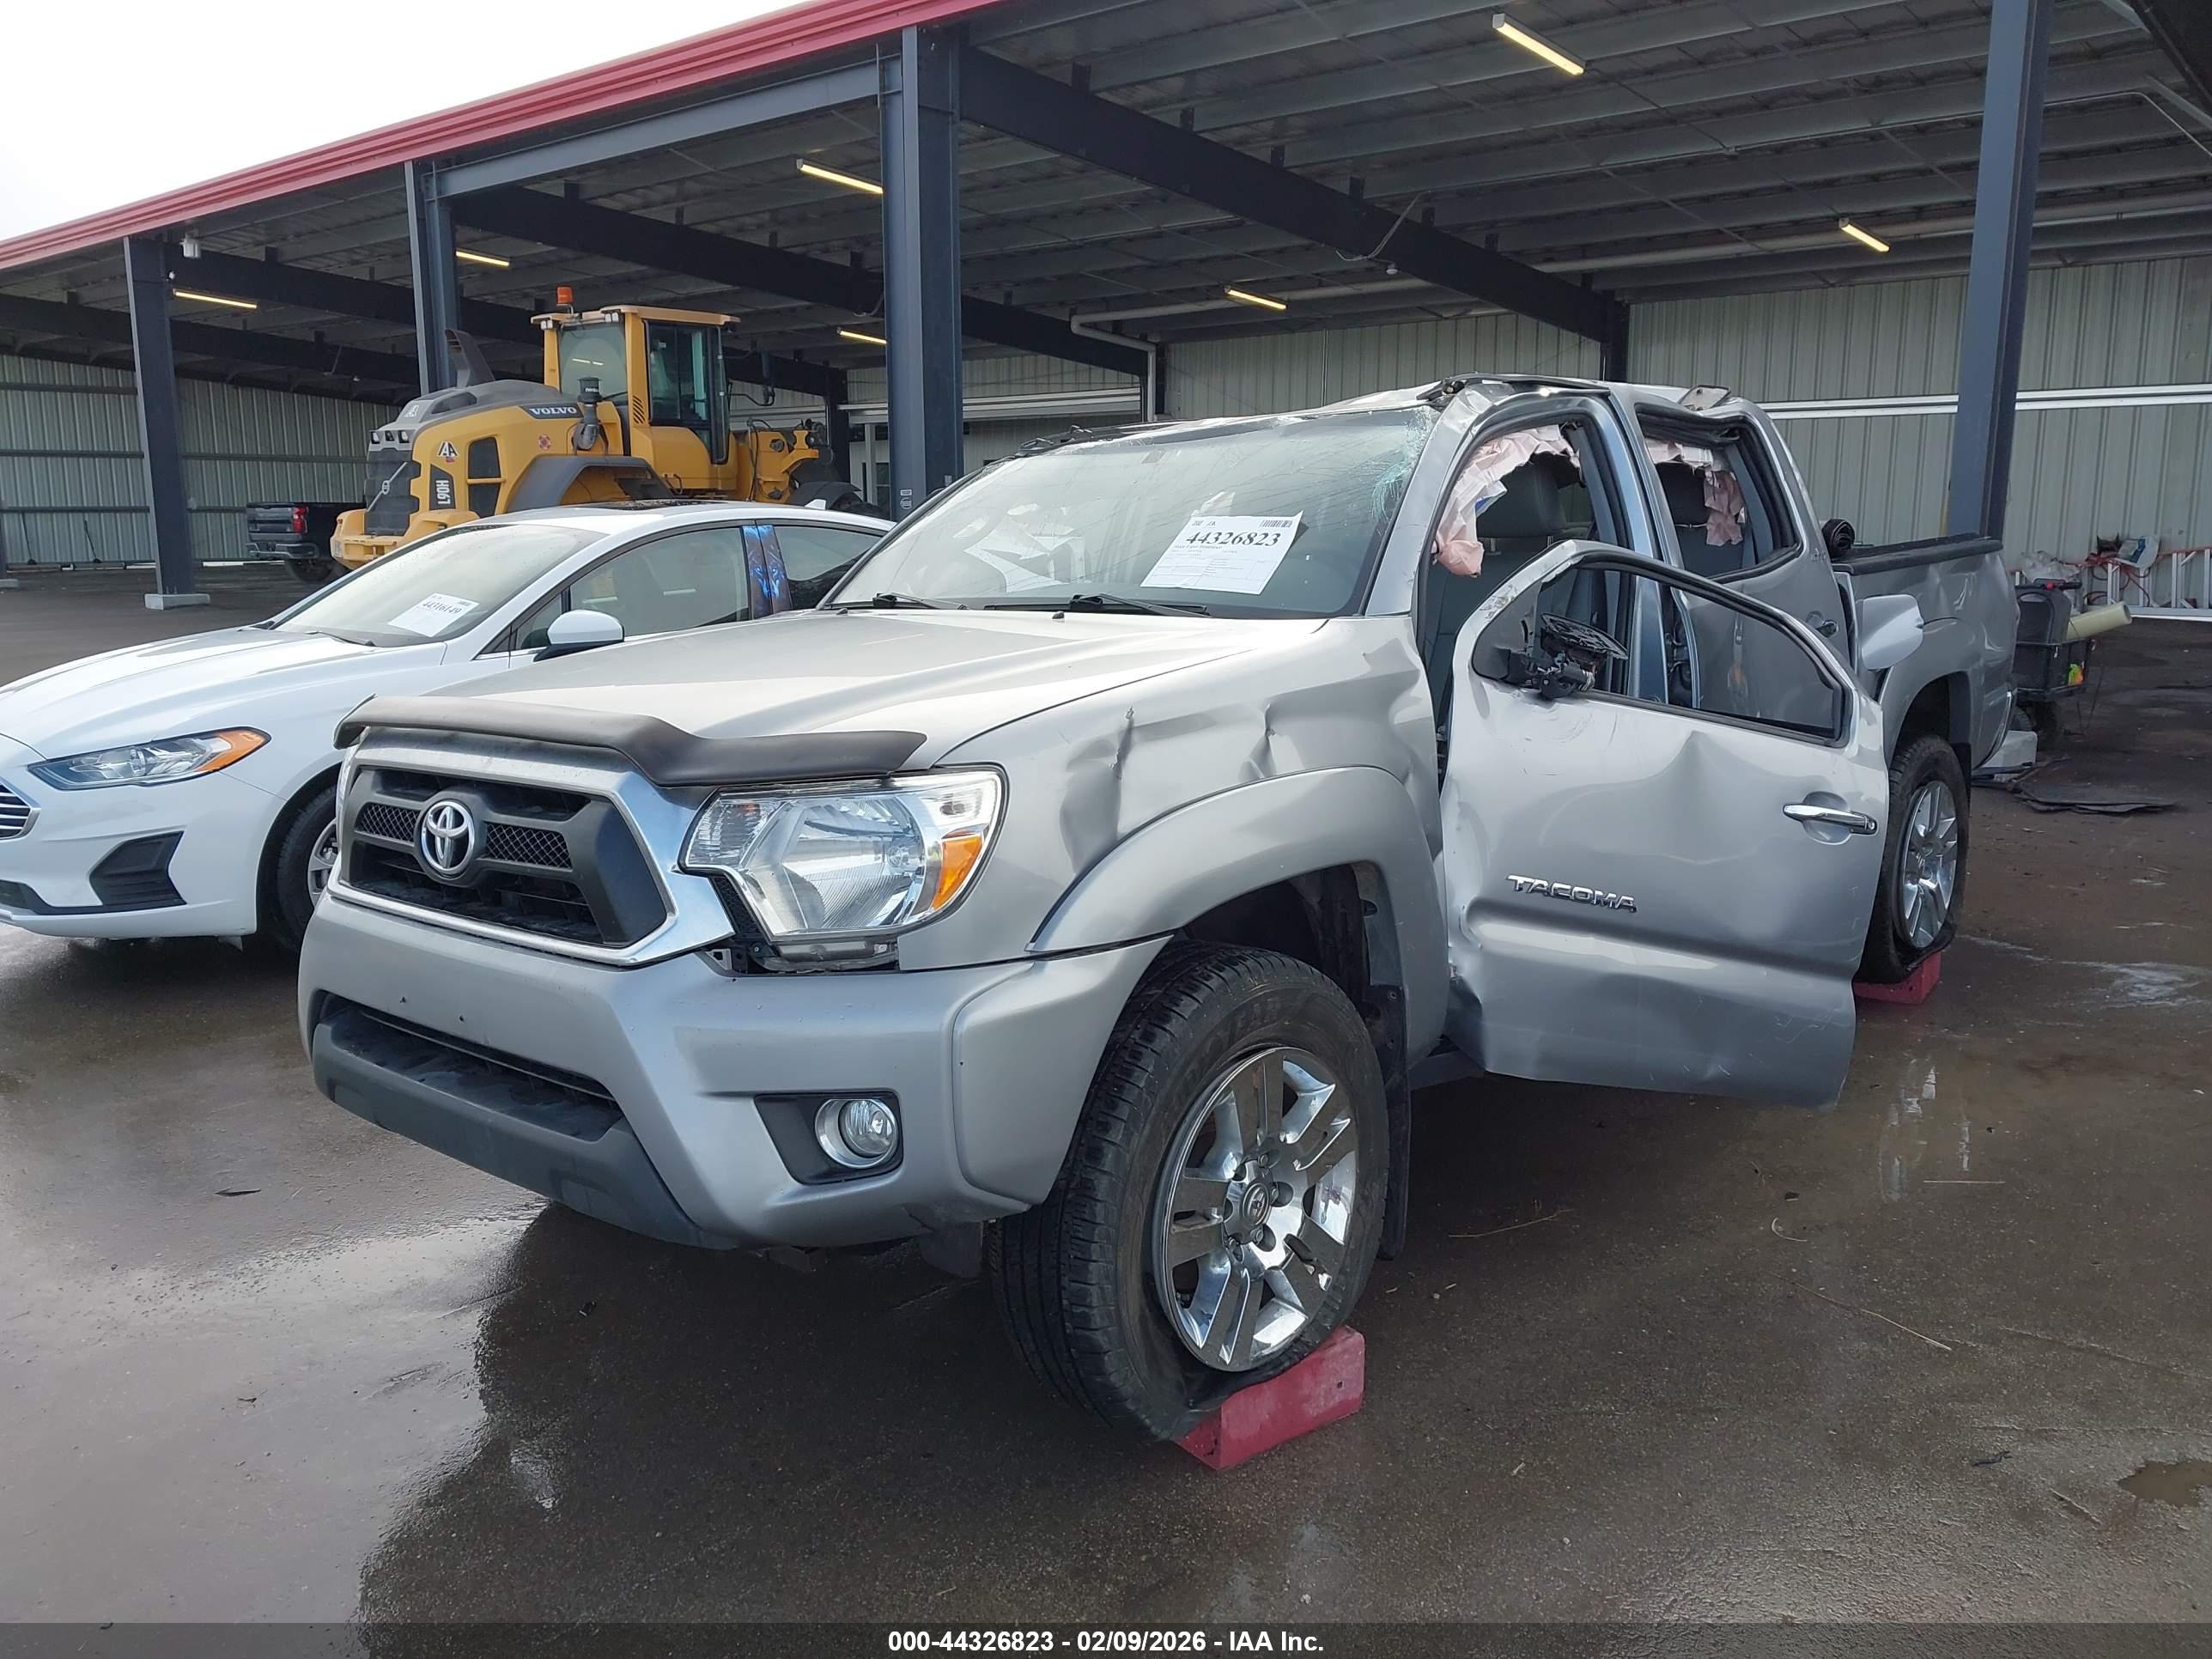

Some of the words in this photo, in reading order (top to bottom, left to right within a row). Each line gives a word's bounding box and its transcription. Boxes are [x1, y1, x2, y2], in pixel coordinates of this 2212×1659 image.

[529, 406, 578, 415] VOLVO
[435, 480, 451, 505] L90H
[1186, 531, 1281, 547] 44326823
[1506, 874, 1638, 913] TACOMA
